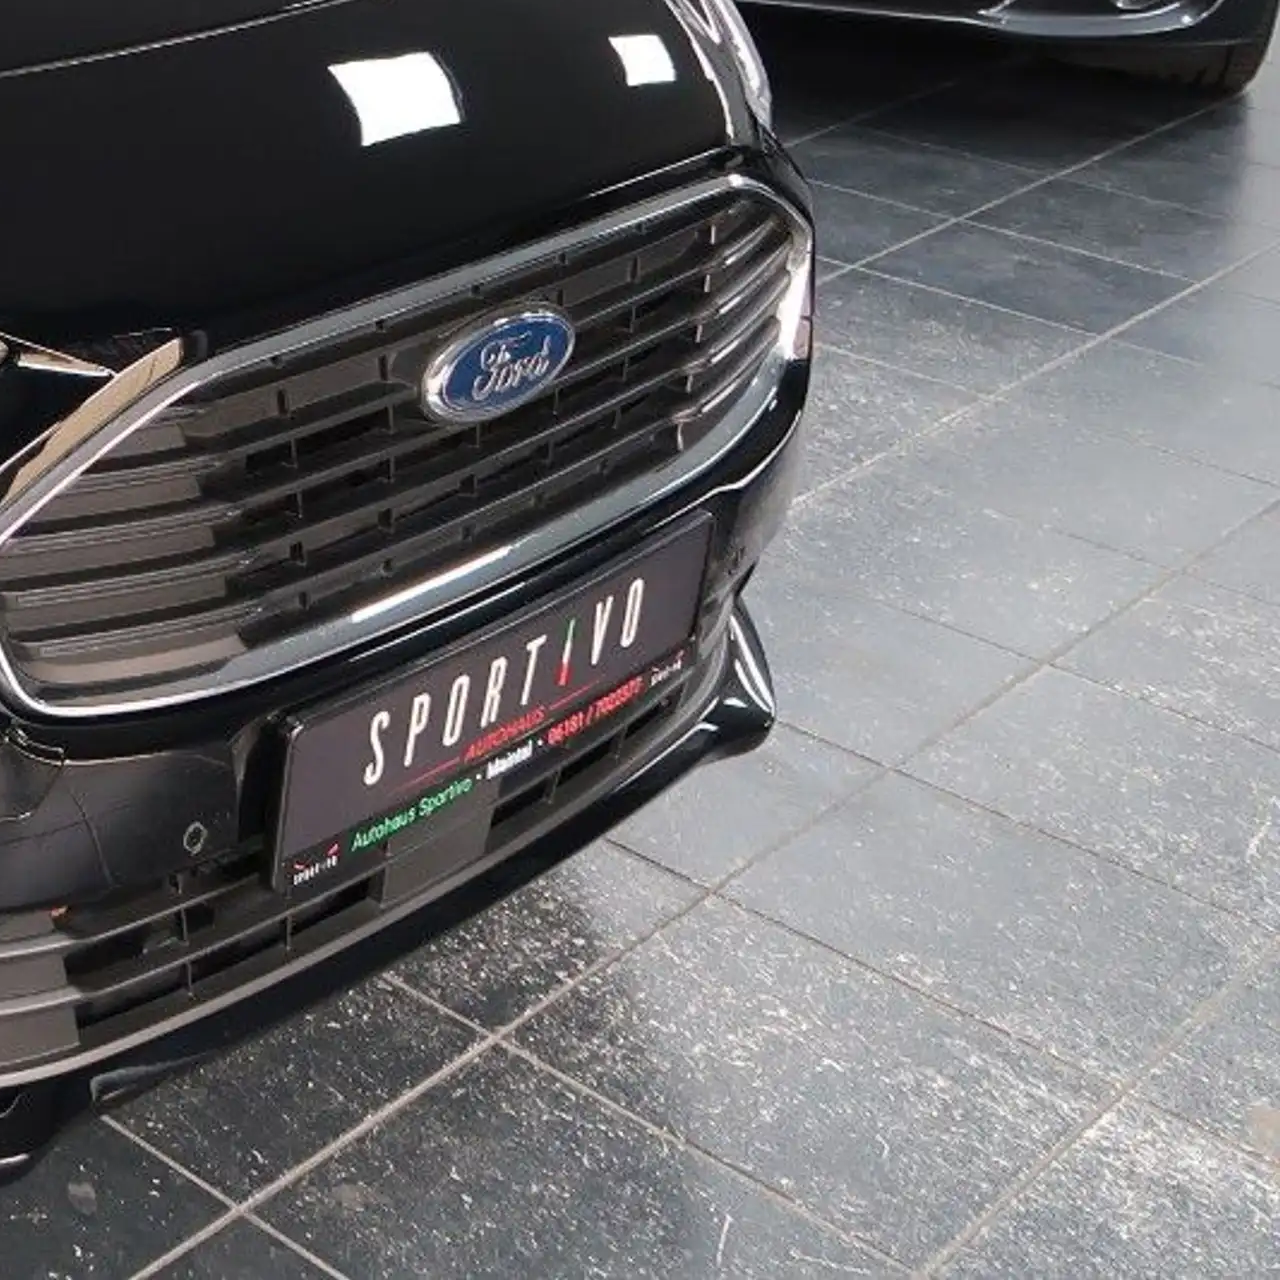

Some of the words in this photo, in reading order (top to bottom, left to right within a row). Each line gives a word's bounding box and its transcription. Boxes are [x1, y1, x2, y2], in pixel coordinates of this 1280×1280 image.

[471, 330, 552, 401] Ford
[363, 578, 644, 786] SPORTIVO
[351, 806, 417, 853] Autohaus
[418, 777, 473, 818] Sportivo
